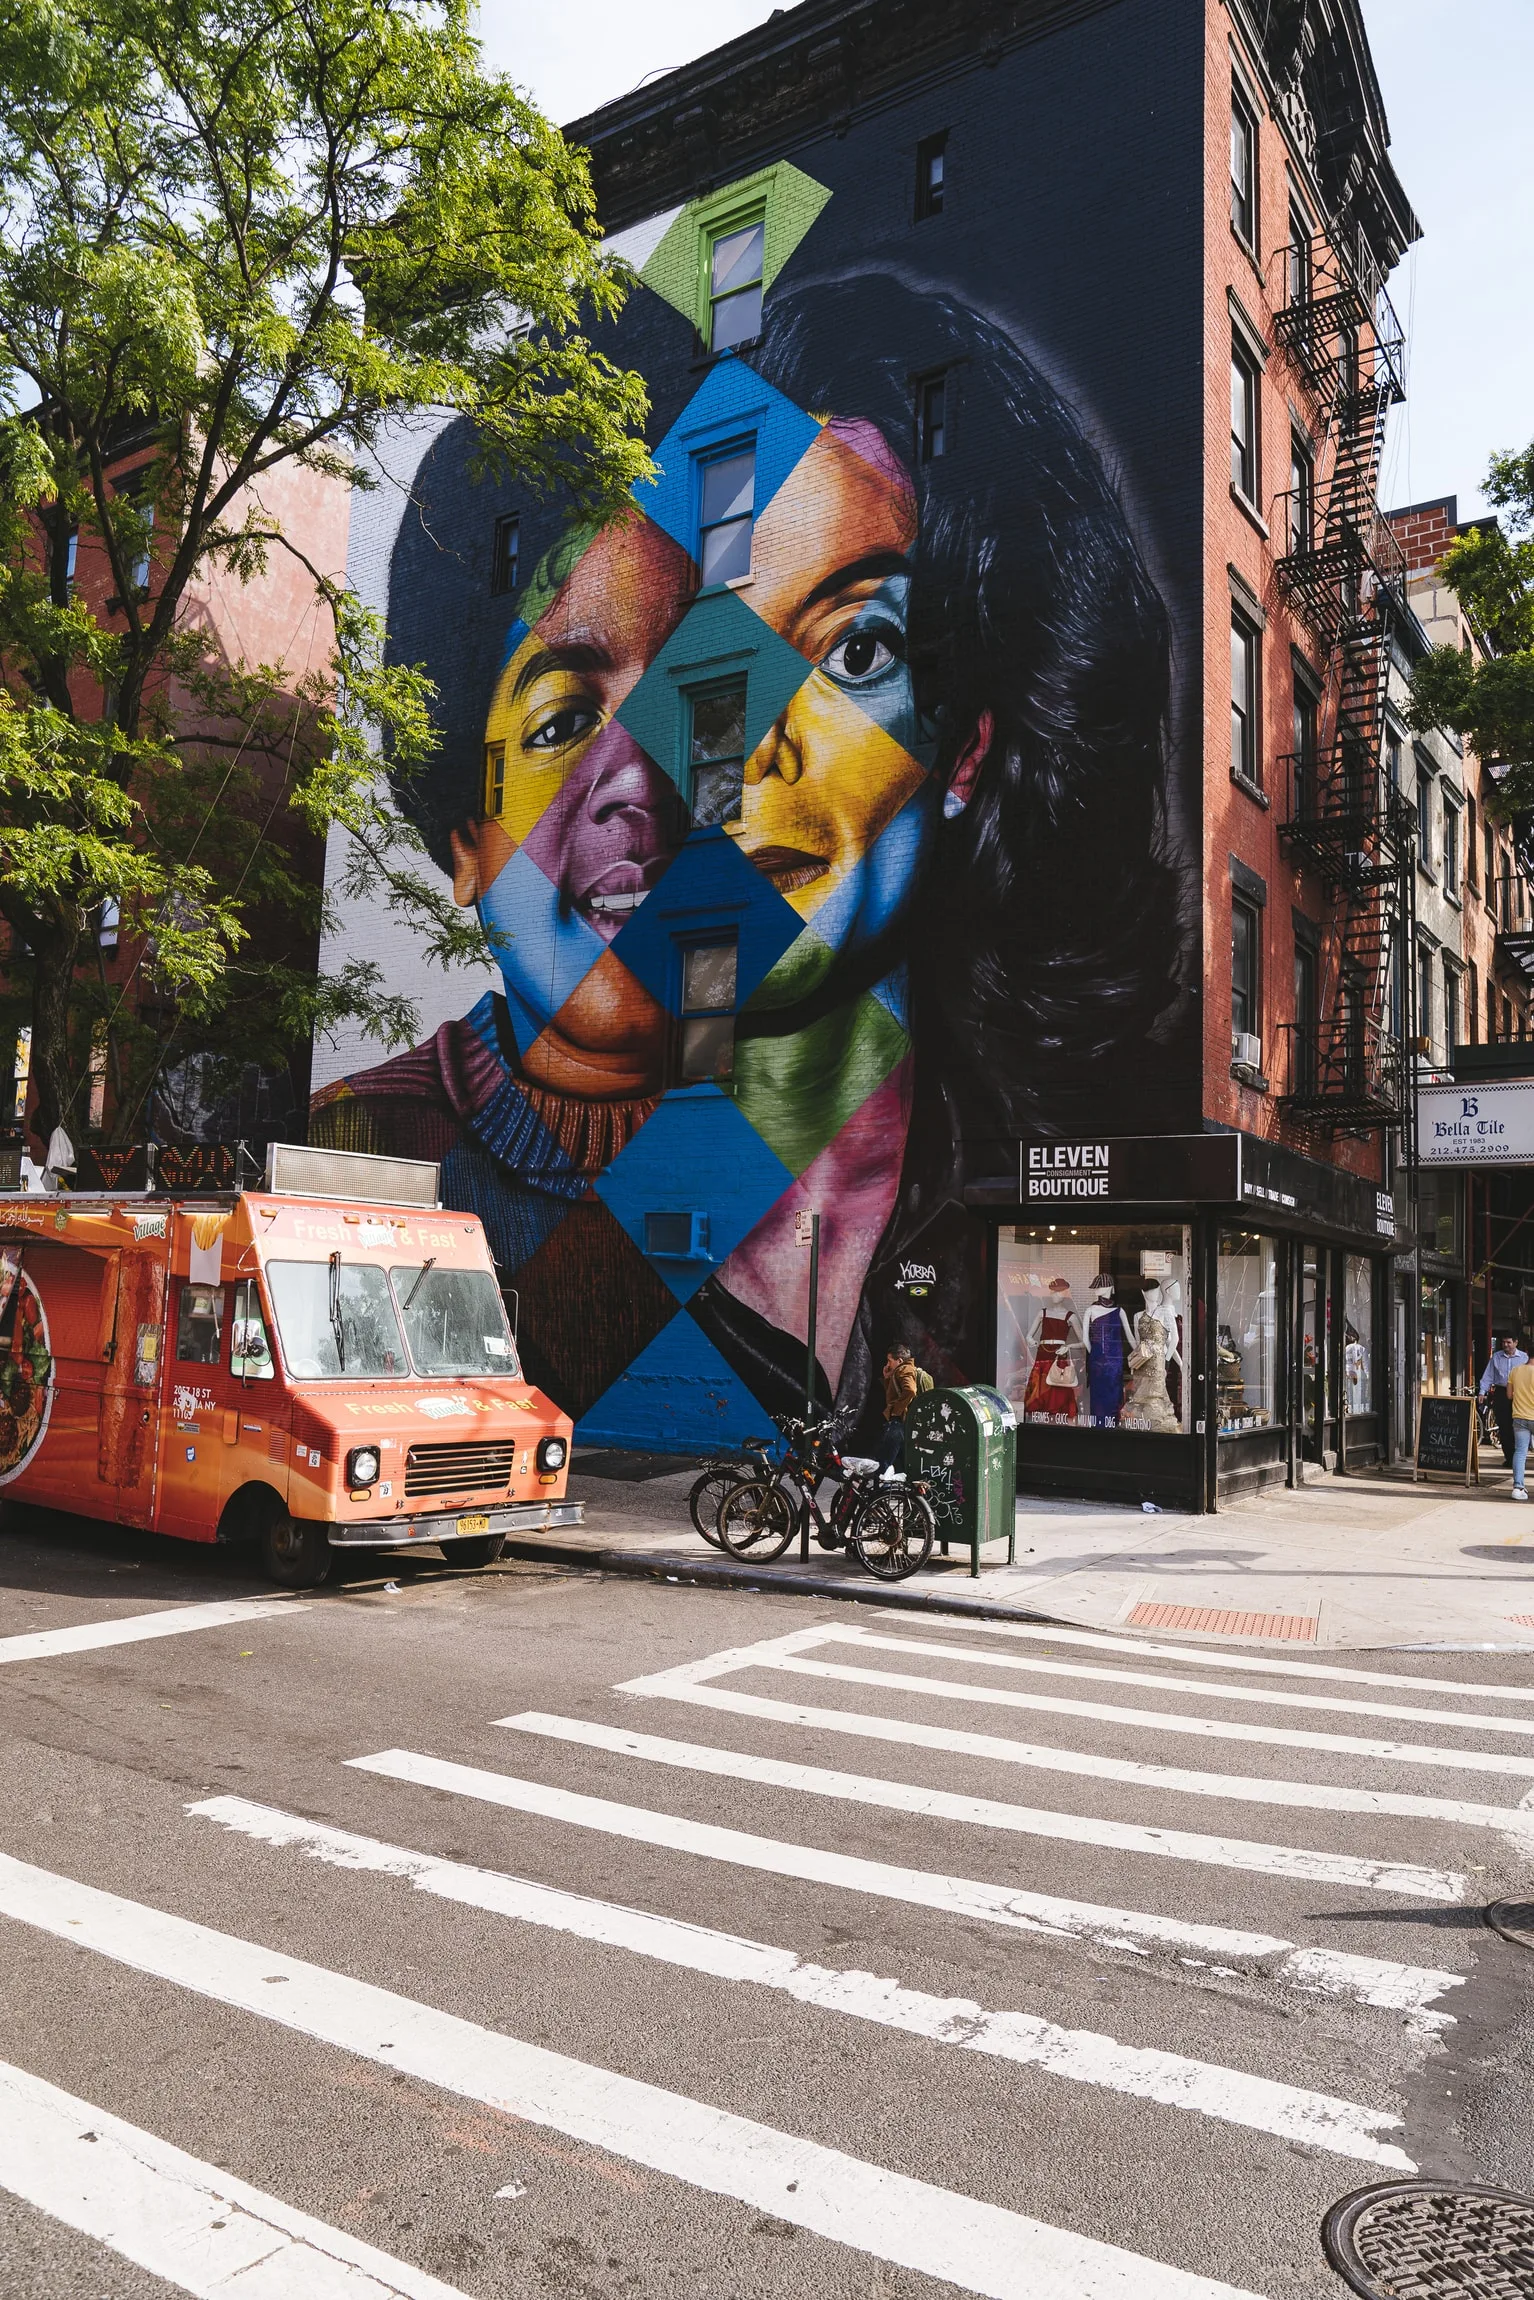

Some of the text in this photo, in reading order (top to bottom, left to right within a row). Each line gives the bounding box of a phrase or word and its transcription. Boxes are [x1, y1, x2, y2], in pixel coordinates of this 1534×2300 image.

[1460, 1096, 1479, 1120] B
[1433, 1119, 1505, 1138] Bella Tile
[1029, 1145, 1109, 1169] ELEVEN
[1430, 1144, 1510, 1155] 212.475.2909
[1046, 1169, 1091, 1177] CONSIGNMENT
[1028, 1178, 1109, 1197] BOUTIQUE
[1256, 1185, 1265, 1198] SELL
[1268, 1189, 1280, 1202] TRADE
[1376, 1191, 1394, 1214] ELEVEN
[134, 1219, 165, 1240] Village
[293, 1219, 351, 1241] Fresh
[400, 1227, 414, 1246] &
[417, 1229, 457, 1248] Fast
[1376, 1218, 1395, 1236] BOUTIQUE
[899, 1260, 937, 1281] KOBRA
[192, 1387, 201, 1398] 18
[201, 1388, 212, 1399] ST
[204, 1400, 216, 1411] NY
[344, 1397, 538, 1416] Fresh & Fast
